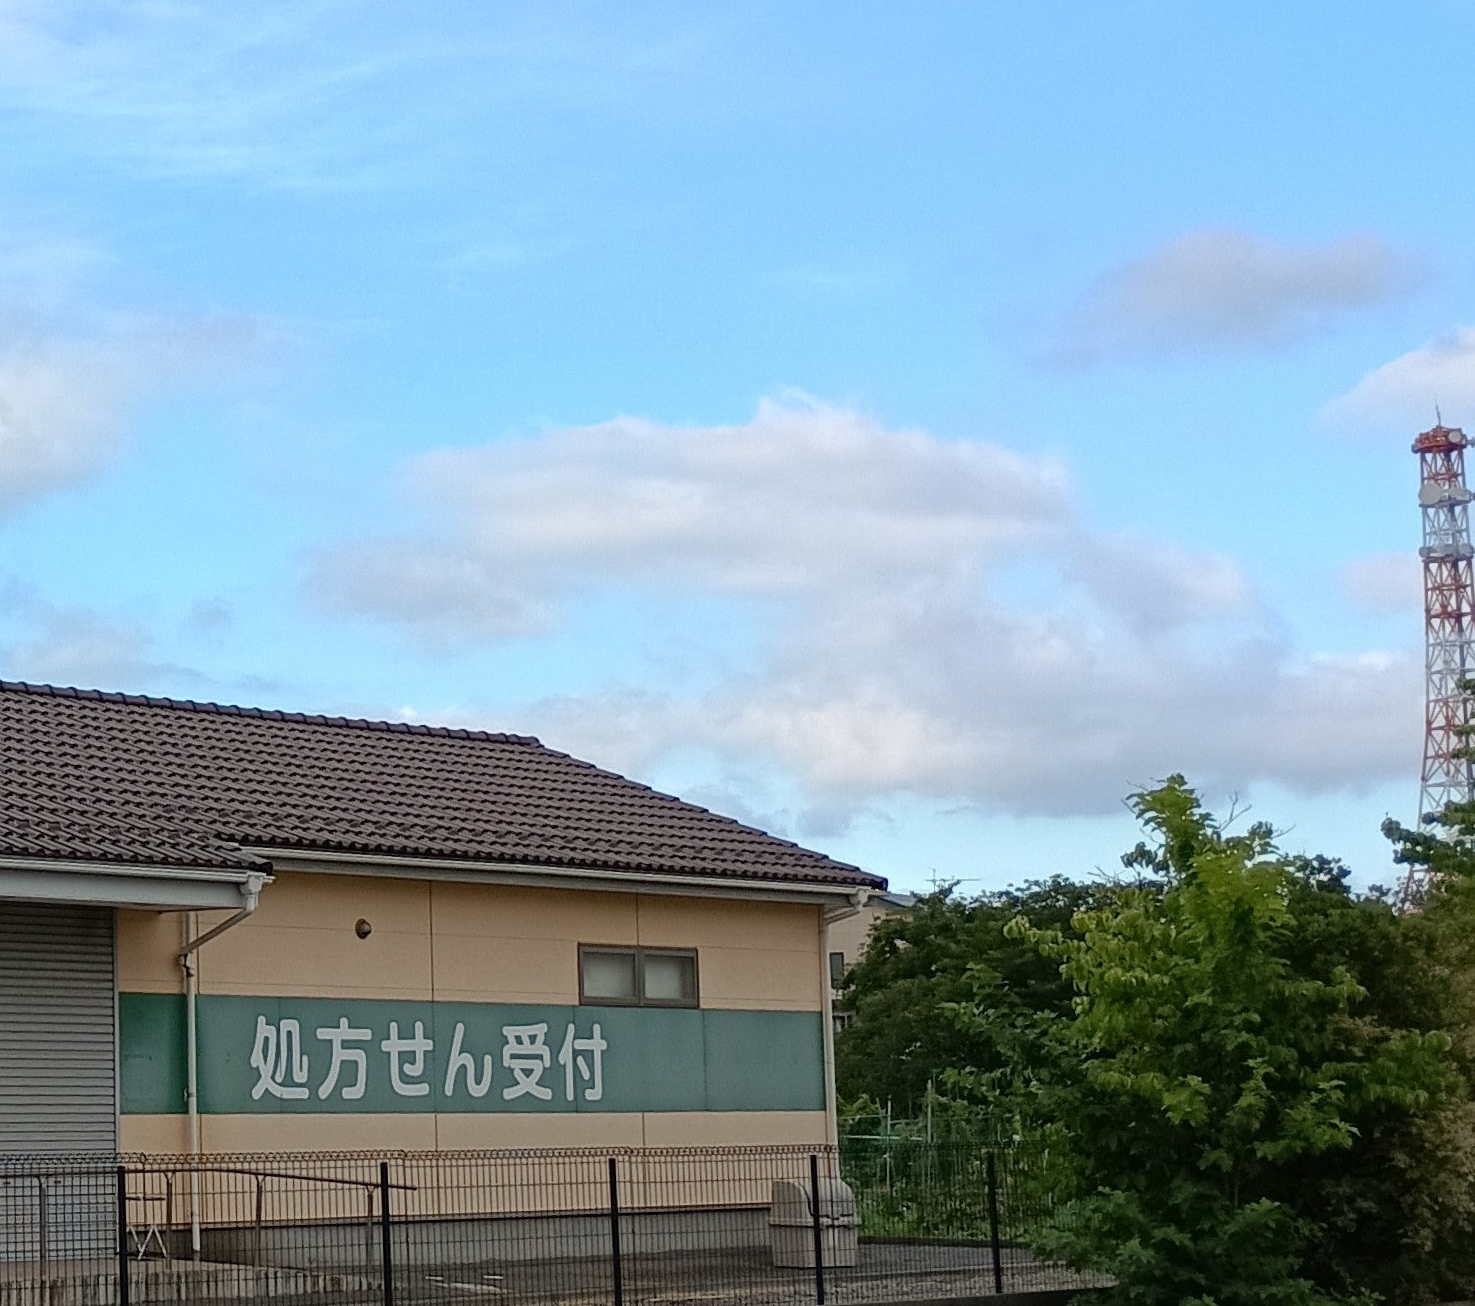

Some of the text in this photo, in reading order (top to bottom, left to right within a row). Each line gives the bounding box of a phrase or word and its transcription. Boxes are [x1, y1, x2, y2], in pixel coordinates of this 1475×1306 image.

[250, 1014, 607, 1101] 処方せん受付
